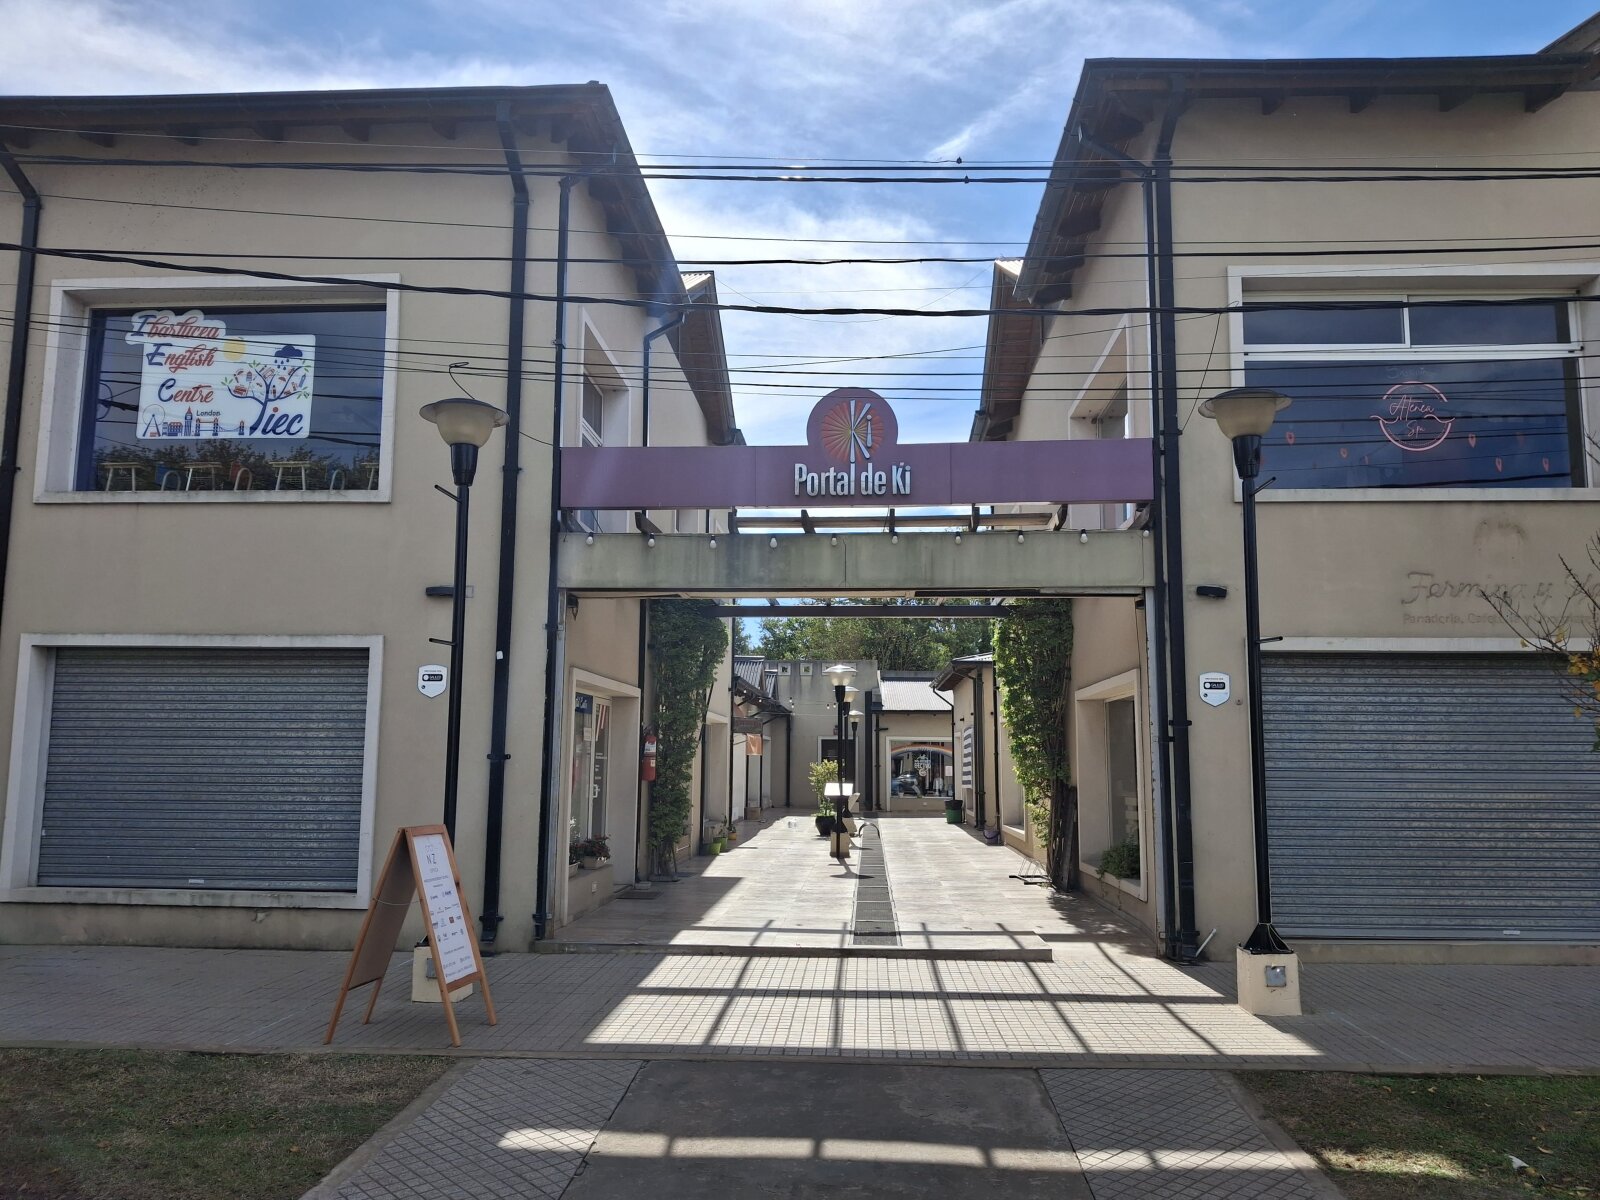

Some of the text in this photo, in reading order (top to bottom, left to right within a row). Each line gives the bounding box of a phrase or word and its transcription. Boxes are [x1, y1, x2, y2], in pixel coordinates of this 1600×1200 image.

[146, 342, 217, 374] English
[157, 378, 214, 403] Centre
[794, 462, 911, 496] Portal de Ki
